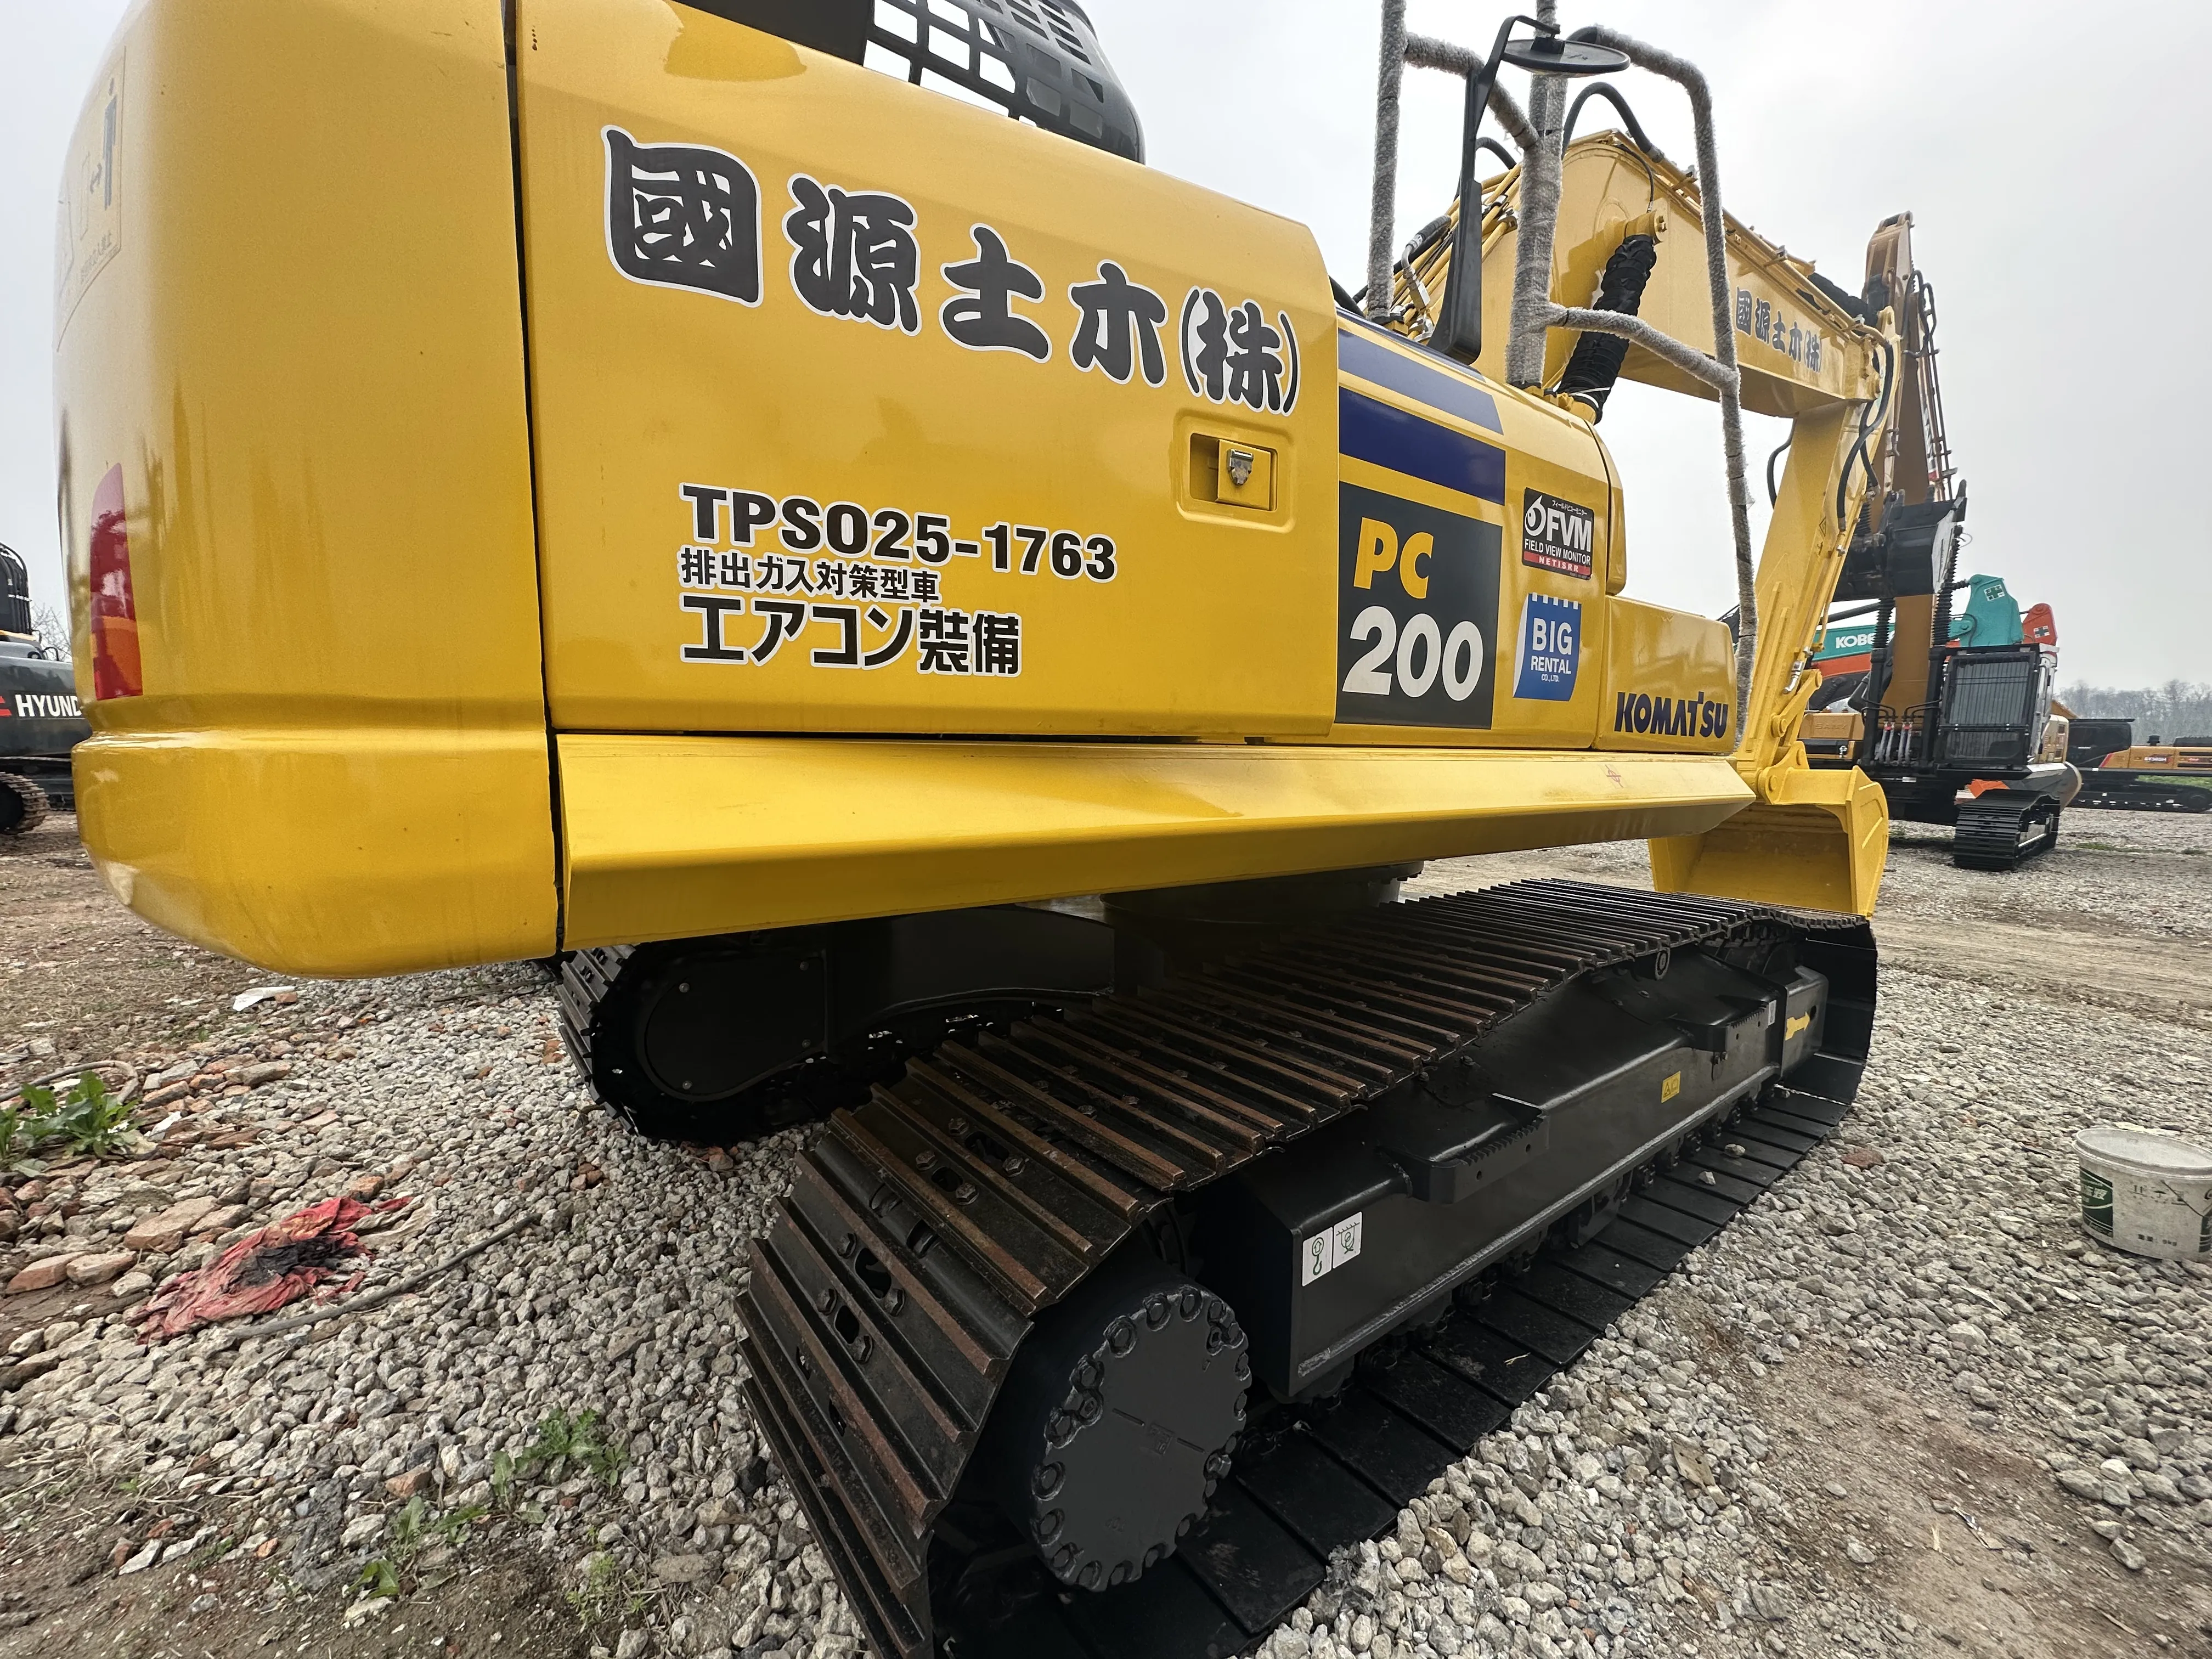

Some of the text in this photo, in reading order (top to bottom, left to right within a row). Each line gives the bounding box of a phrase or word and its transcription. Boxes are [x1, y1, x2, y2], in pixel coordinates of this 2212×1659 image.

[1525, 538, 1591, 566] FIELD VIEW MONITOR
[1547, 507, 1592, 552] FVM
[679, 547, 941, 603] 排出ガス対策型車
[1353, 517, 1434, 599] PC
[680, 594, 1022, 676] エアコン装備
[1342, 606, 1483, 702] 200
[1532, 618, 1572, 655] BIG
[1531, 656, 1572, 674] RENTAL
[1614, 691, 1728, 739] KOMATSU
